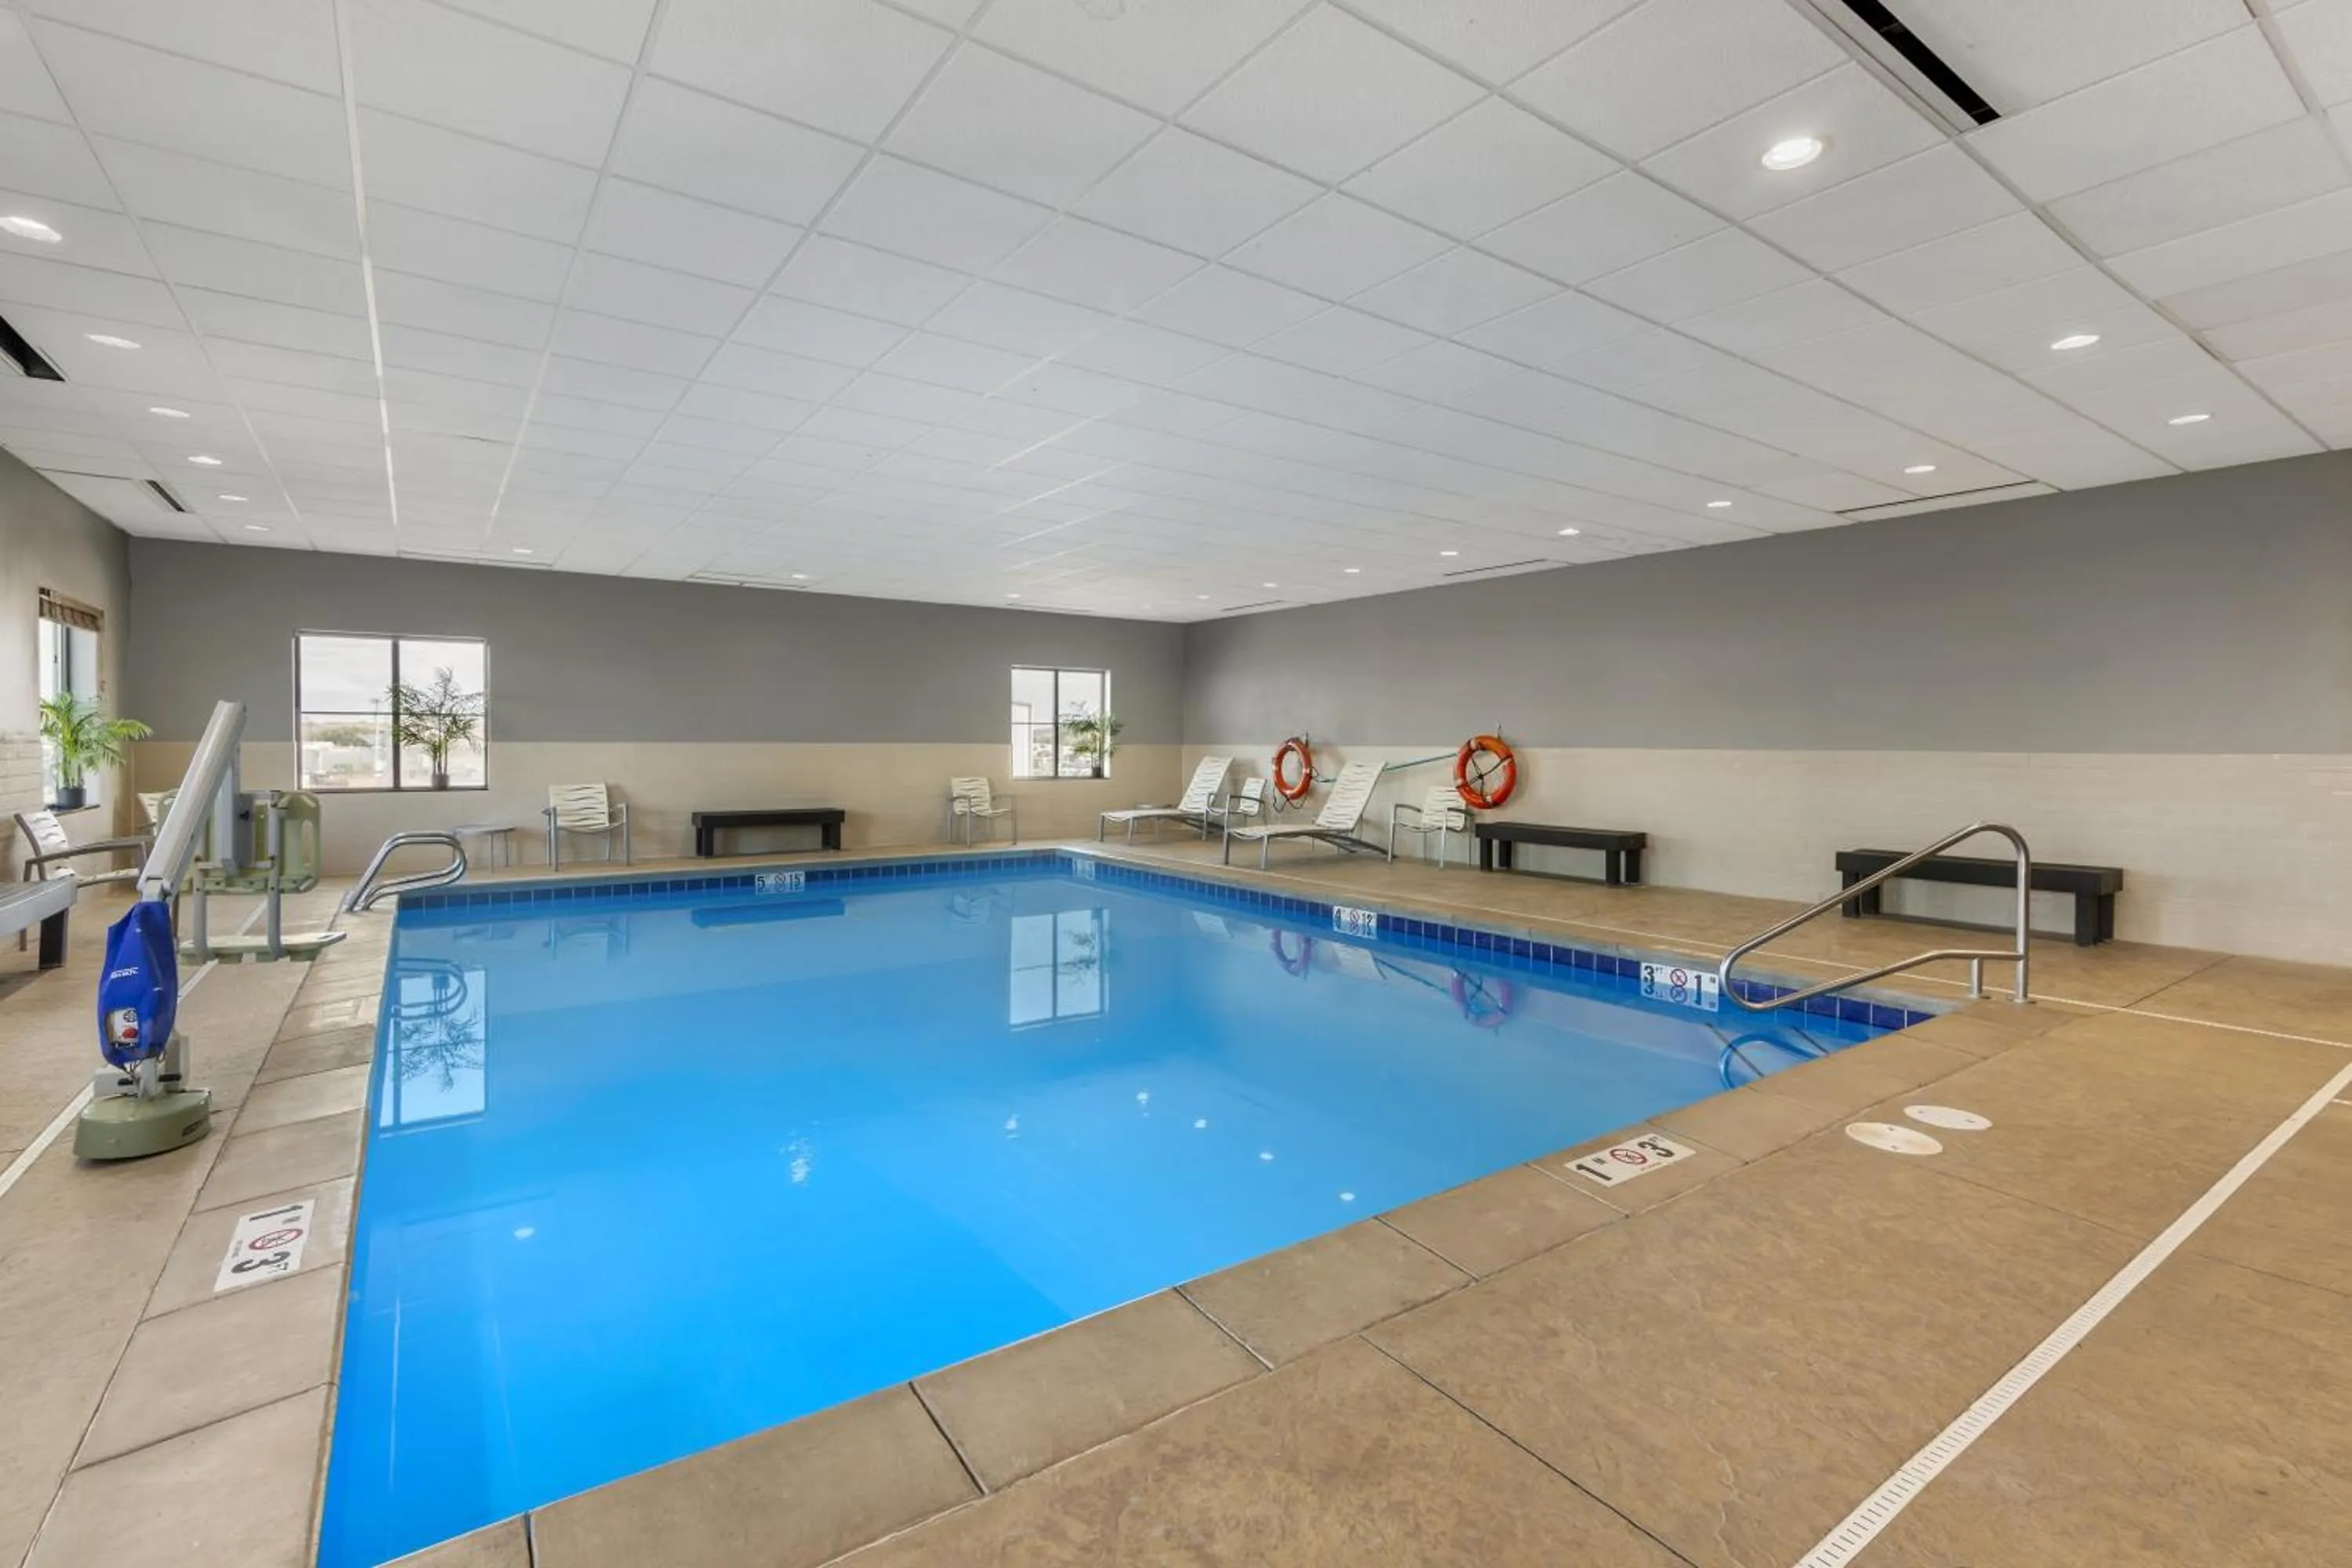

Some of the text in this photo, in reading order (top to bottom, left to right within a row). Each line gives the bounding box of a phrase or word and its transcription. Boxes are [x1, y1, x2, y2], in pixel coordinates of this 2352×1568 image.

[757, 876, 766, 887] 5
[1643, 965, 1655, 984] 3
[1694, 974, 1702, 991] 1
[1576, 1163, 1612, 1181] 1
[1638, 1141, 1675, 1158] 3
[249, 1204, 304, 1222] 1
[231, 1250, 291, 1274] 3
